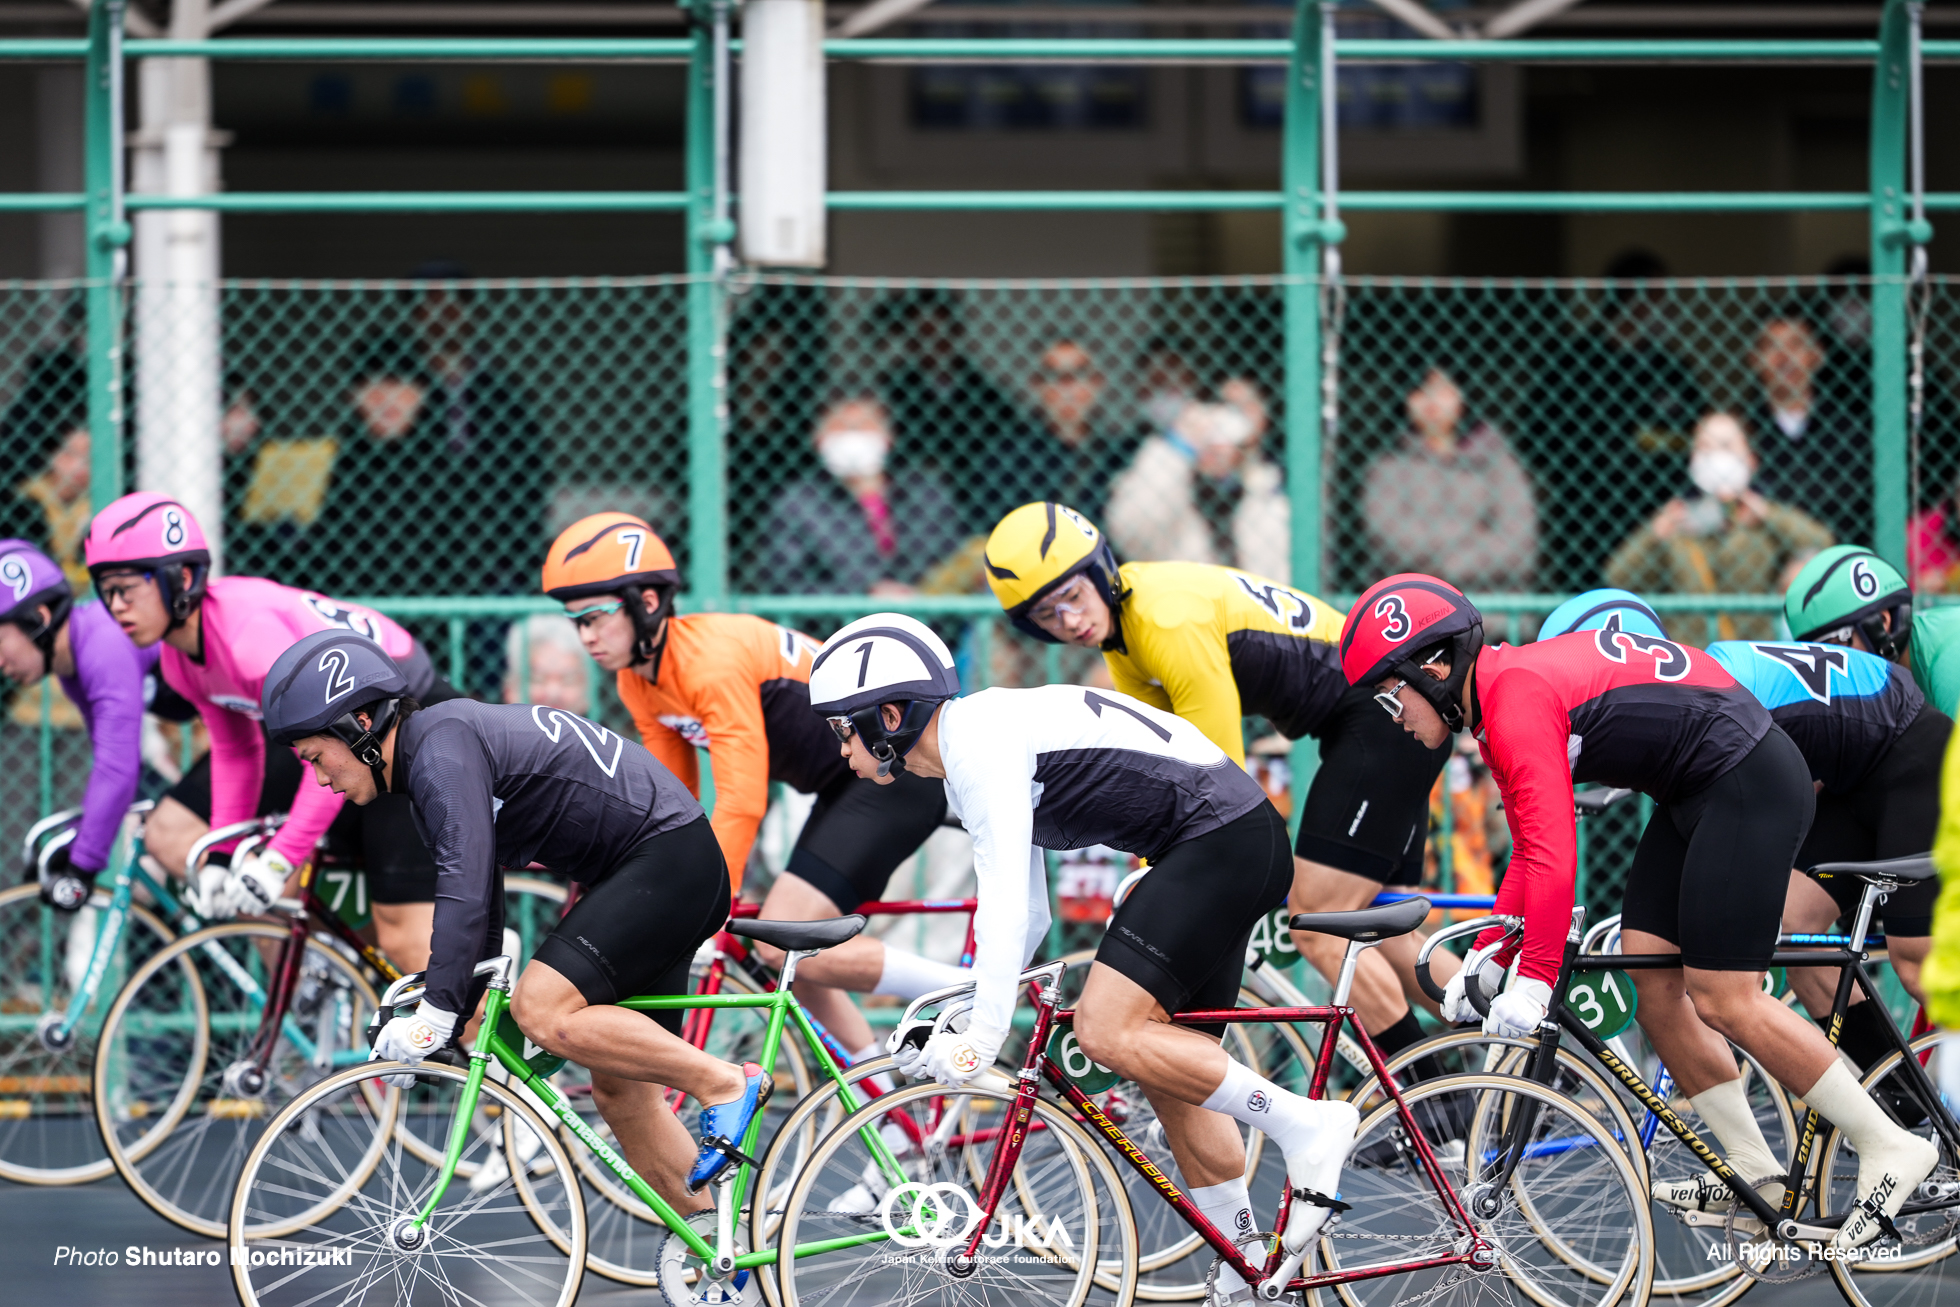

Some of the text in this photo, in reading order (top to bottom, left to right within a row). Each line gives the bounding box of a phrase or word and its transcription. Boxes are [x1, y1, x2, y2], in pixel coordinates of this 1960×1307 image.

[162, 506, 187, 551] 8
[617, 529, 646, 571] 7
[0, 553, 33, 602] 9
[1226, 570, 1316, 634] 5
[1850, 557, 1880, 602] 6
[1375, 594, 1412, 642] 3
[1417, 605, 1451, 628] KEIRIN
[318, 648, 355, 704] 2
[358, 670, 390, 687] KEIRIN
[854, 641, 874, 689] 1
[1594, 629, 1692, 682] 3
[1748, 641, 1848, 706] 4
[1084, 690, 1172, 743] 1
[532, 705, 624, 778] 2
[325, 871, 368, 916] 71
[1249, 908, 1298, 955] 48
[1569, 971, 1628, 1029] 31
[1598, 1049, 1735, 1180] BRIDGESTONE
[551, 1099, 636, 1181] Panasonic
